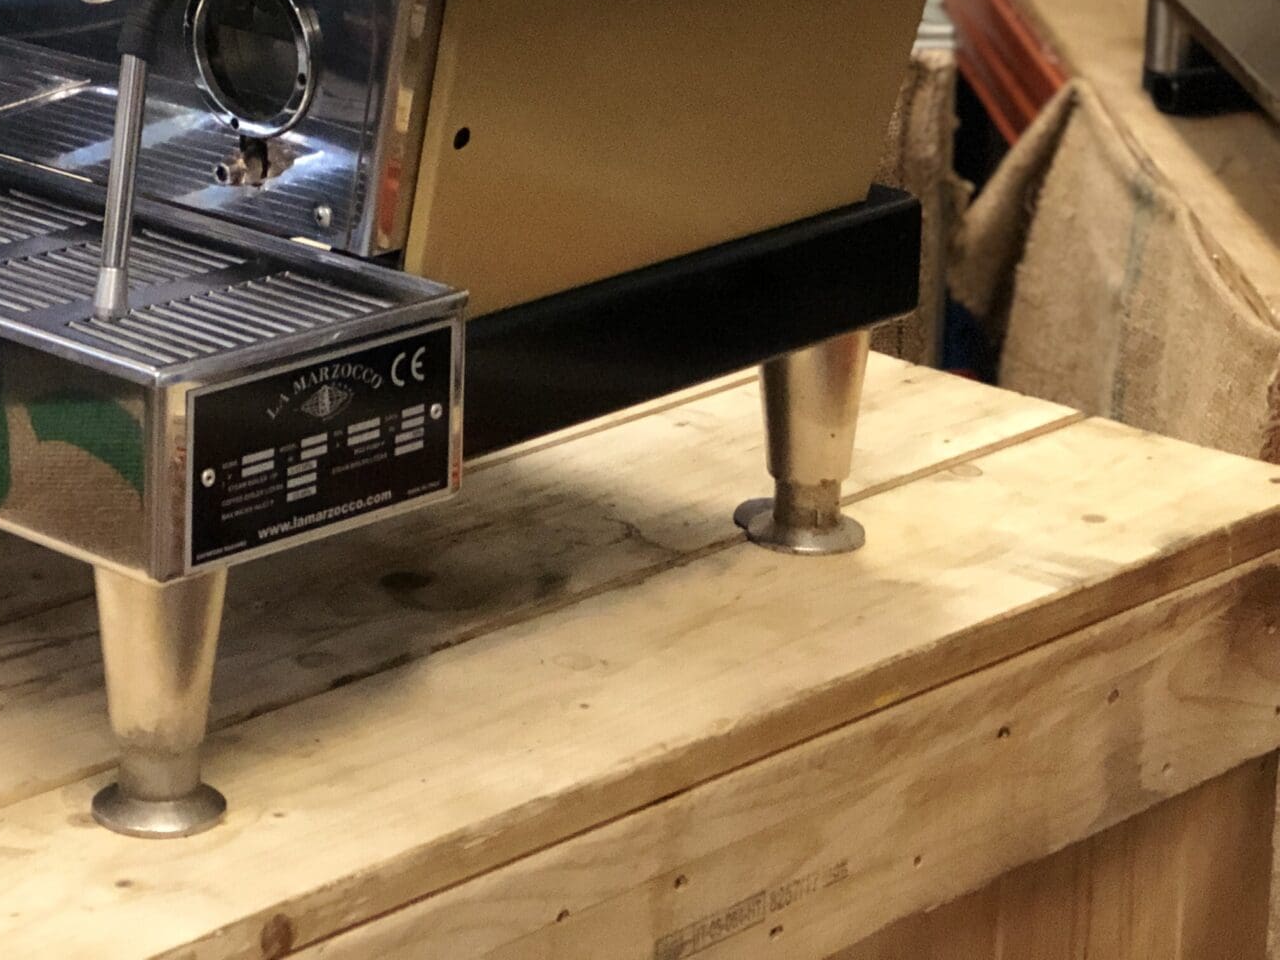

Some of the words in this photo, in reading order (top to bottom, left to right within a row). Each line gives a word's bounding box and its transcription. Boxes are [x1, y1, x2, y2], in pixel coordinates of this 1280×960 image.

[266, 393, 290, 420] LA
[292, 363, 383, 395] MARZOCCO
[257, 490, 392, 539] www.lamarzocco.com
